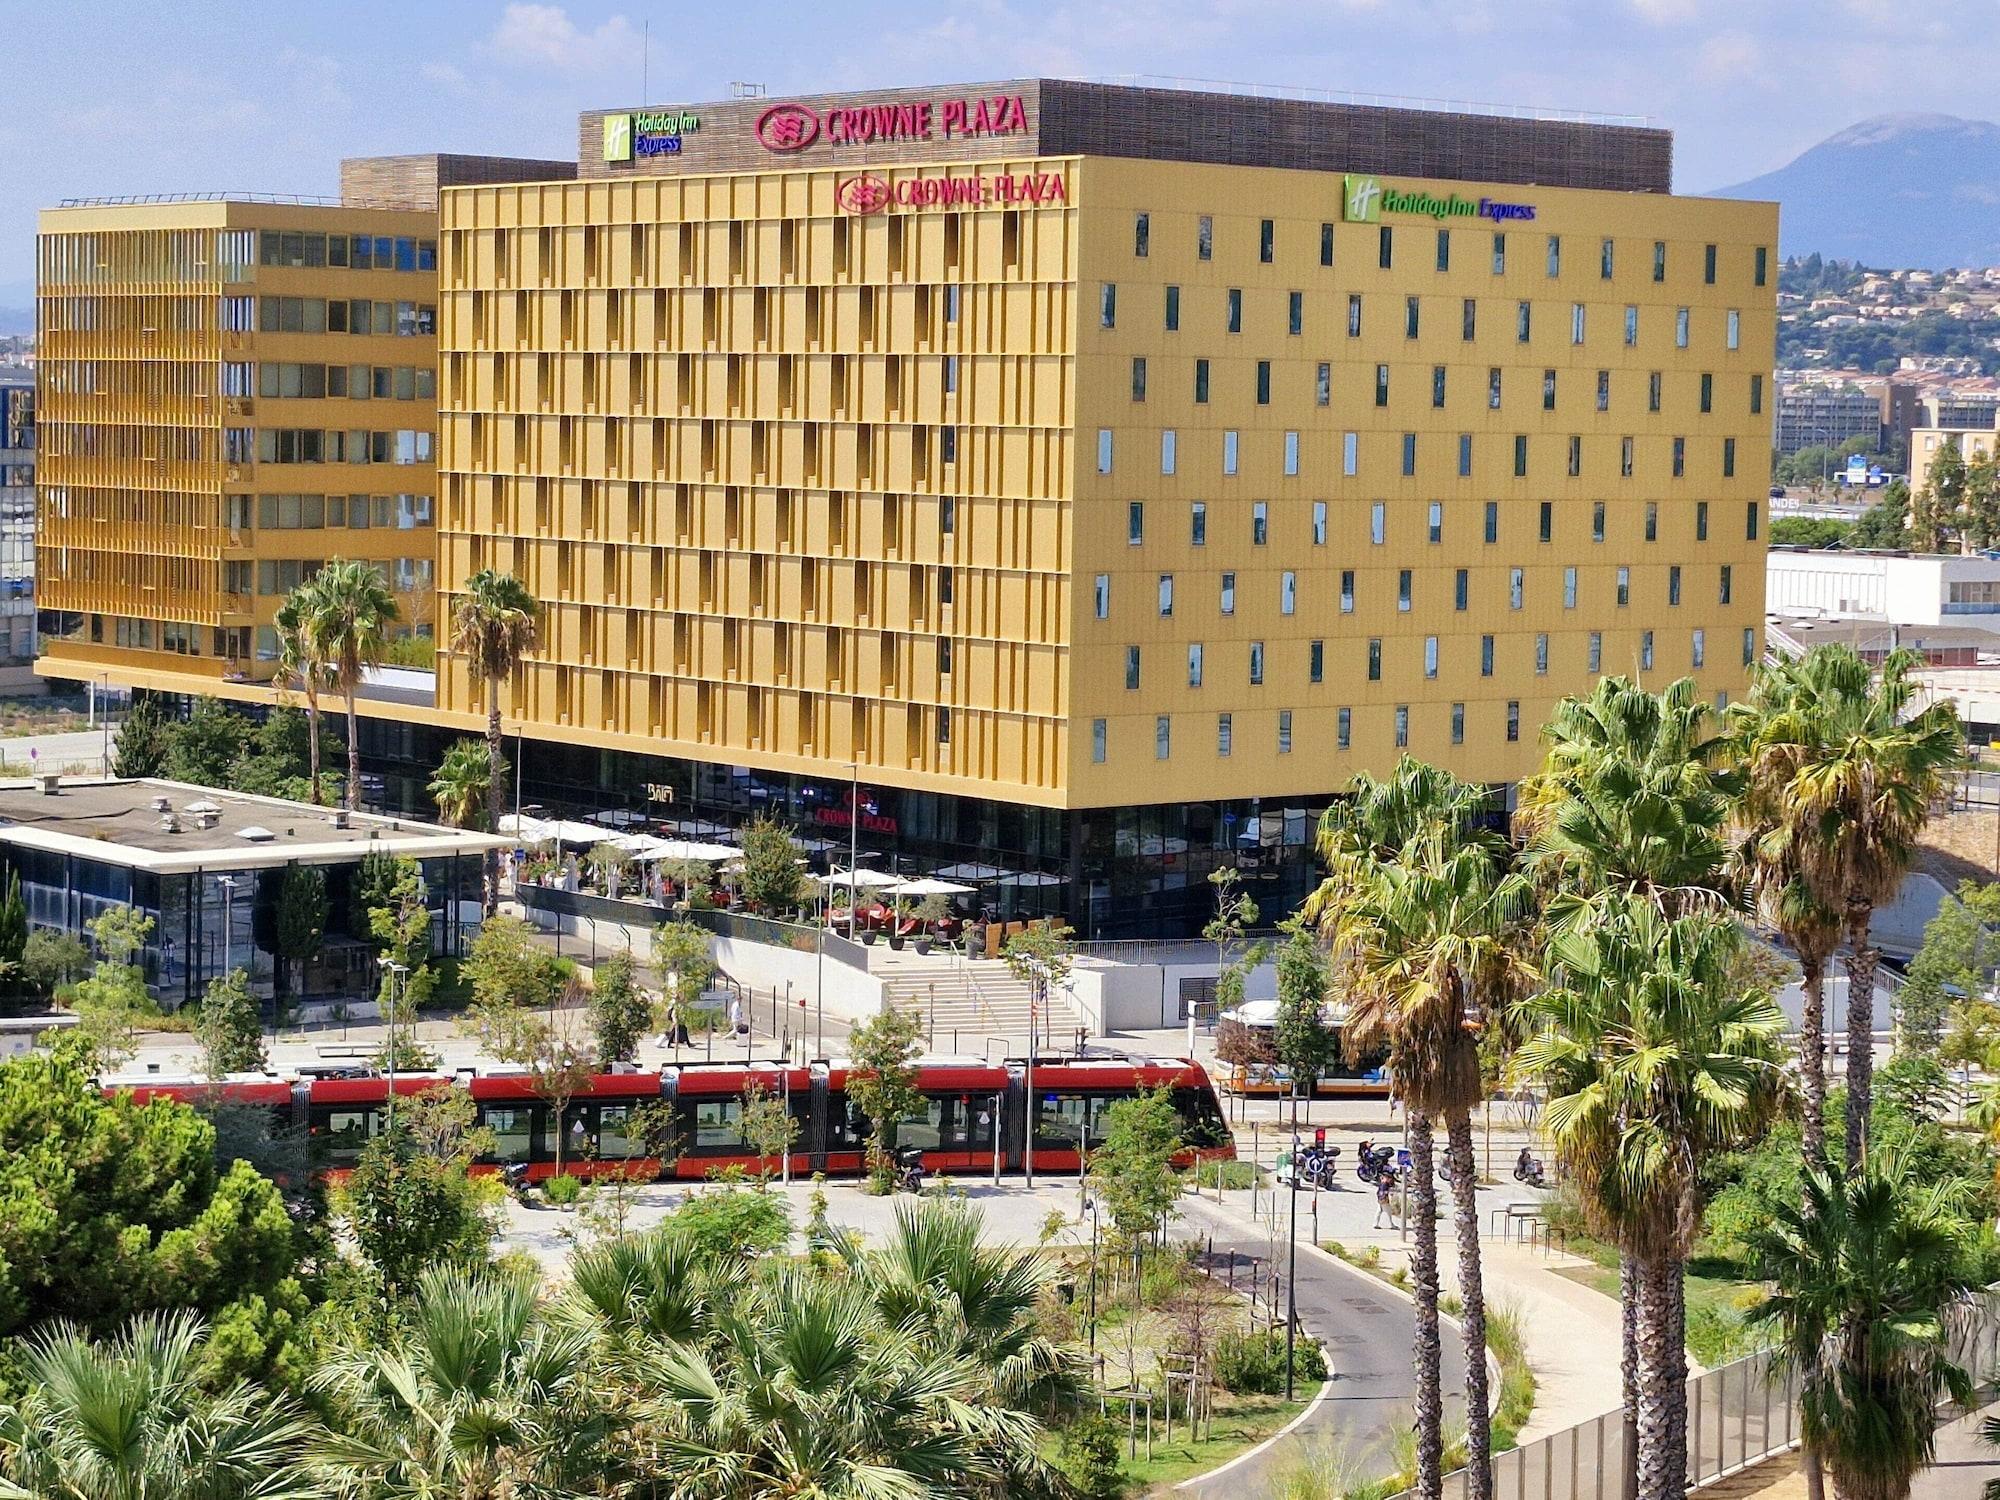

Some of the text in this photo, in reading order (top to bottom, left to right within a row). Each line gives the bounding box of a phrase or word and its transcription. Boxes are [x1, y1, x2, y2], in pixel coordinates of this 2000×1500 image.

[636, 110, 698, 135] Holiday Inn
[825, 95, 1028, 143] CROWNE PLAZA
[635, 134, 681, 156] Express
[896, 173, 1066, 206] CROWNE PLAZA
[1383, 188, 1537, 223] Holiday Inn Express
[816, 806, 897, 835] CROWN PLAZA
